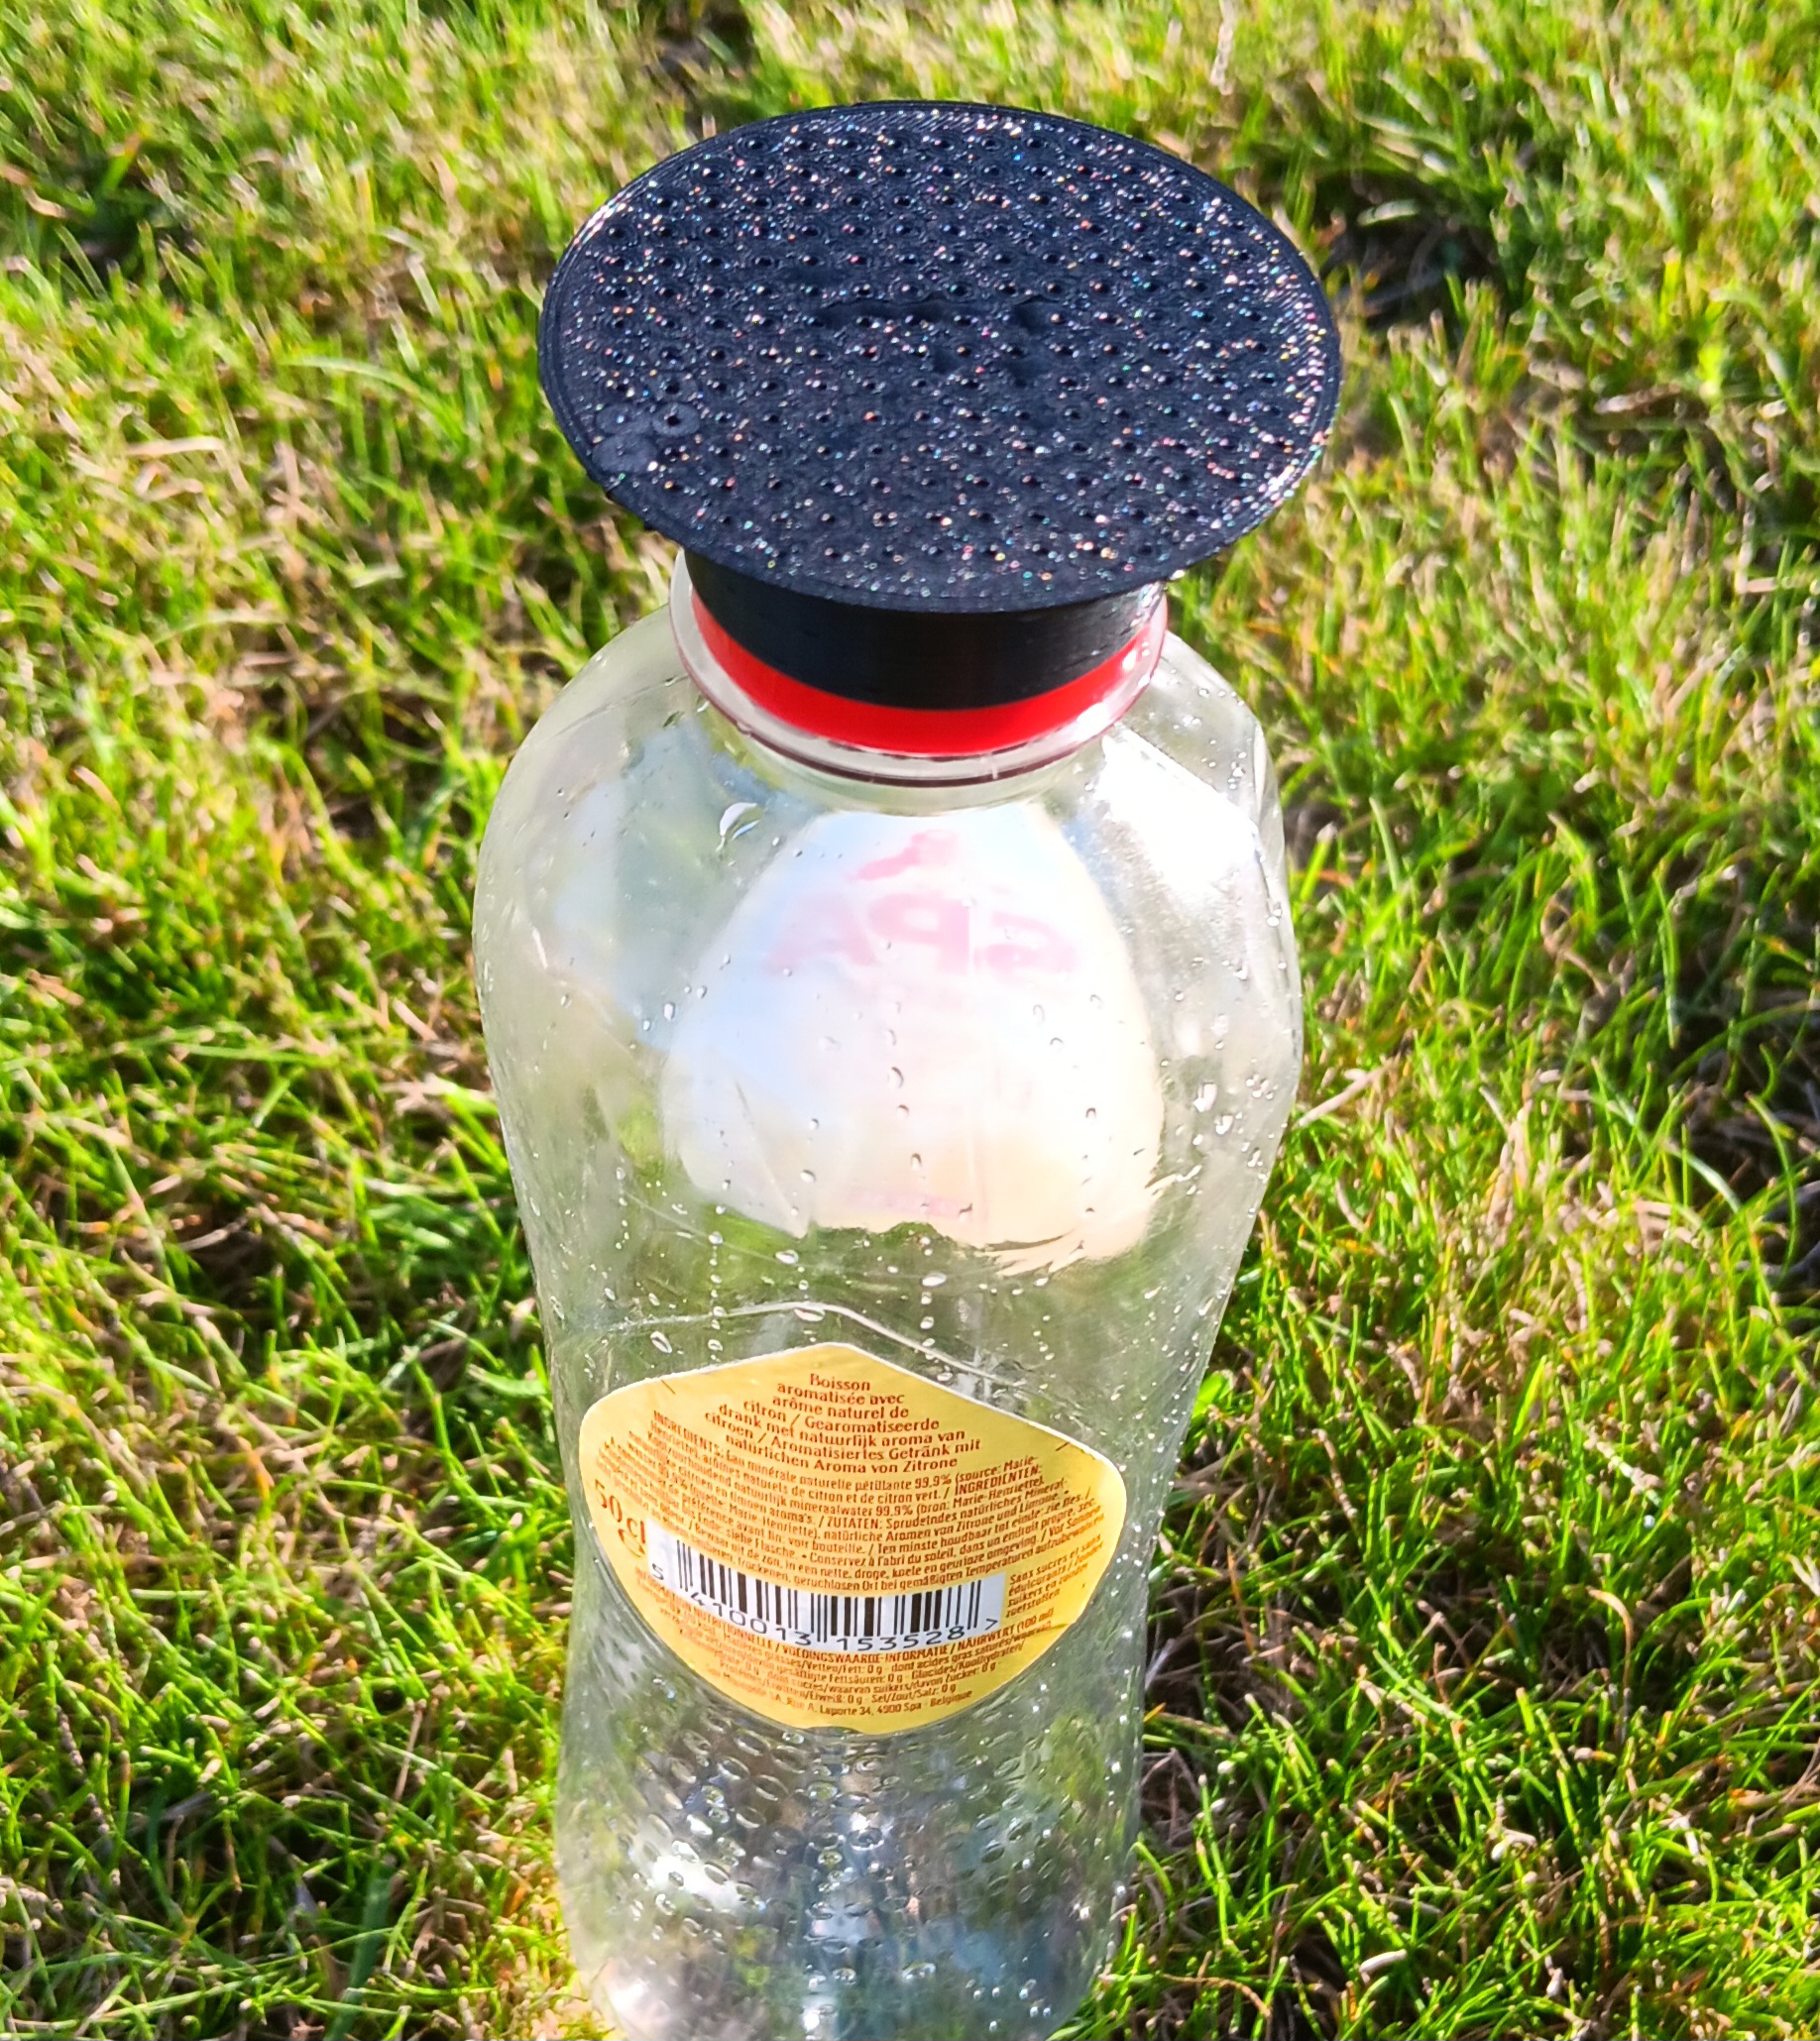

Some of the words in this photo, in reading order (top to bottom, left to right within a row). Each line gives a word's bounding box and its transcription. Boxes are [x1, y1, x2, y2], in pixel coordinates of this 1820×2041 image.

[777, 1383, 864, 1405] aromatisée
[869, 1394, 904, 1405] avec
[810, 1373, 870, 1392] Boisson
[743, 1399, 786, 1422] citron
[804, 1416, 940, 1434] Gearomatiseerde
[772, 1395, 822, 1415] arôme
[828, 1405, 884, 1419] naturel
[889, 1405, 909, 1418] de
[705, 1411, 753, 1439] citroen
[770, 1435, 884, 1461] Aromatisiertes
[888, 1442, 951, 1461] Getränk
[954, 1437, 981, 1454] mit
[719, 1404, 762, 1428] drank
[766, 1420, 794, 1437] met
[799, 1428, 876, 1449] natuurlijk
[881, 1433, 933, 1447] aroma
[937, 1430, 967, 1441] van
[725, 1433, 809, 1469] natürlichen
[813, 1458, 866, 1474] Aroma
[870, 1462, 898, 1474] von
[902, 1456, 958, 1473] Zitrone
[742, 1472, 789, 1495] naturels
[791, 1485, 806, 1498] de
[808, 1490, 844, 1504] citron
[846, 1493, 857, 1504] et
[859, 1492, 875, 1505] de
[877, 1492, 913, 1505] citron
[799, 1476, 853, 1491] naturelle
[595, 1479, 624, 1524] 50
[626, 1518, 646, 1544] cl
[823, 1531, 883, 1542] natürliche
[885, 1530, 932, 1542] Aromen
[934, 1526, 955, 1536] von
[956, 1515, 995, 1532] Zitrone
[996, 1506, 1018, 1522] und
[877, 1542, 897, 1555] Ten
[898, 1539, 939, 1554] minste
[940, 1528, 993, 1548] houdbaar
[994, 1521, 1010, 1534] tot
[907, 1553, 922, 1565] du
[959, 1540, 985, 1556] dans
[986, 1536, 1001, 1547] un
[1002, 1521, 1039, 1543] endroit
[798, 1564, 819, 1575] een
[892, 1565, 923, 1579] koele
[923, 1565, 939, 1574] en
[880, 1577, 898, 1591] bei
[651, 1562, 665, 1581] 5
[690, 1591, 812, 1646] 410013
[836, 1625, 966, 1651] 153528
